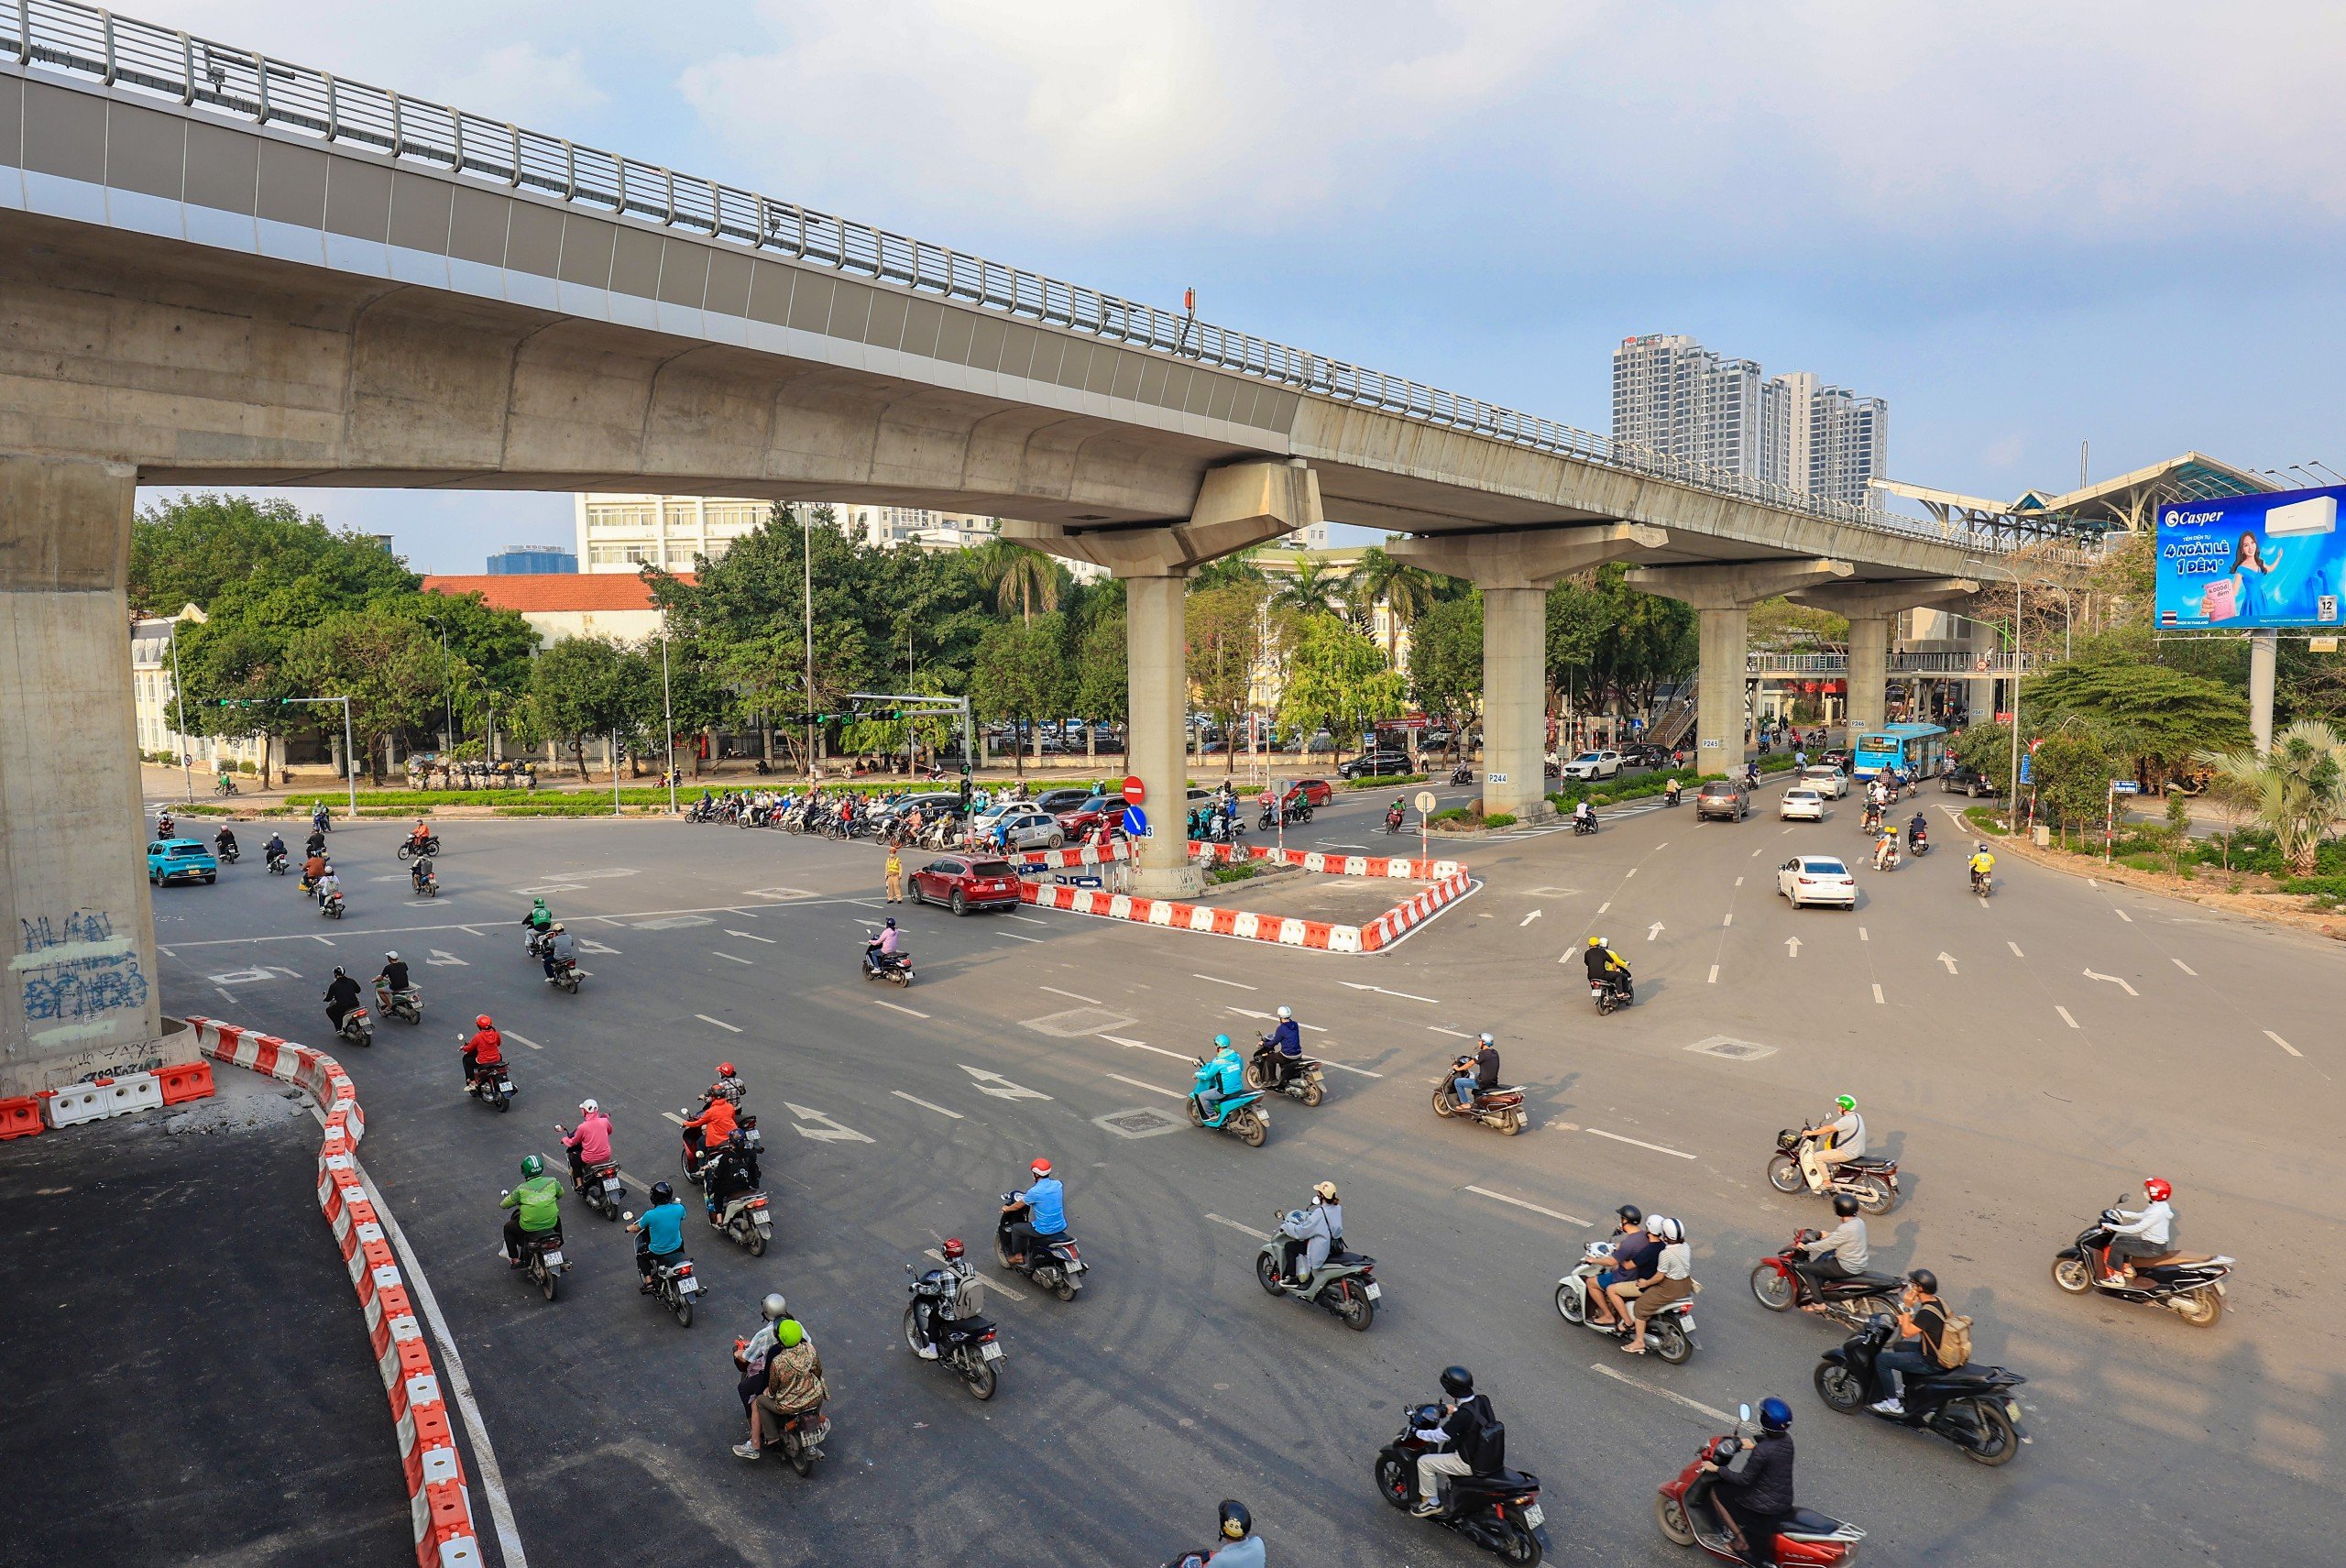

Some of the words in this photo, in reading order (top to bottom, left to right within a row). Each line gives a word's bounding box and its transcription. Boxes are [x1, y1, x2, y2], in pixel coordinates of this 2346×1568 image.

[2179, 511, 2224, 526] Casper
[2164, 543, 2176, 558] 4
[2176, 542, 2213, 557] NGÀN
[2176, 558, 2185, 575] 1
[2322, 601, 2332, 609] 12
